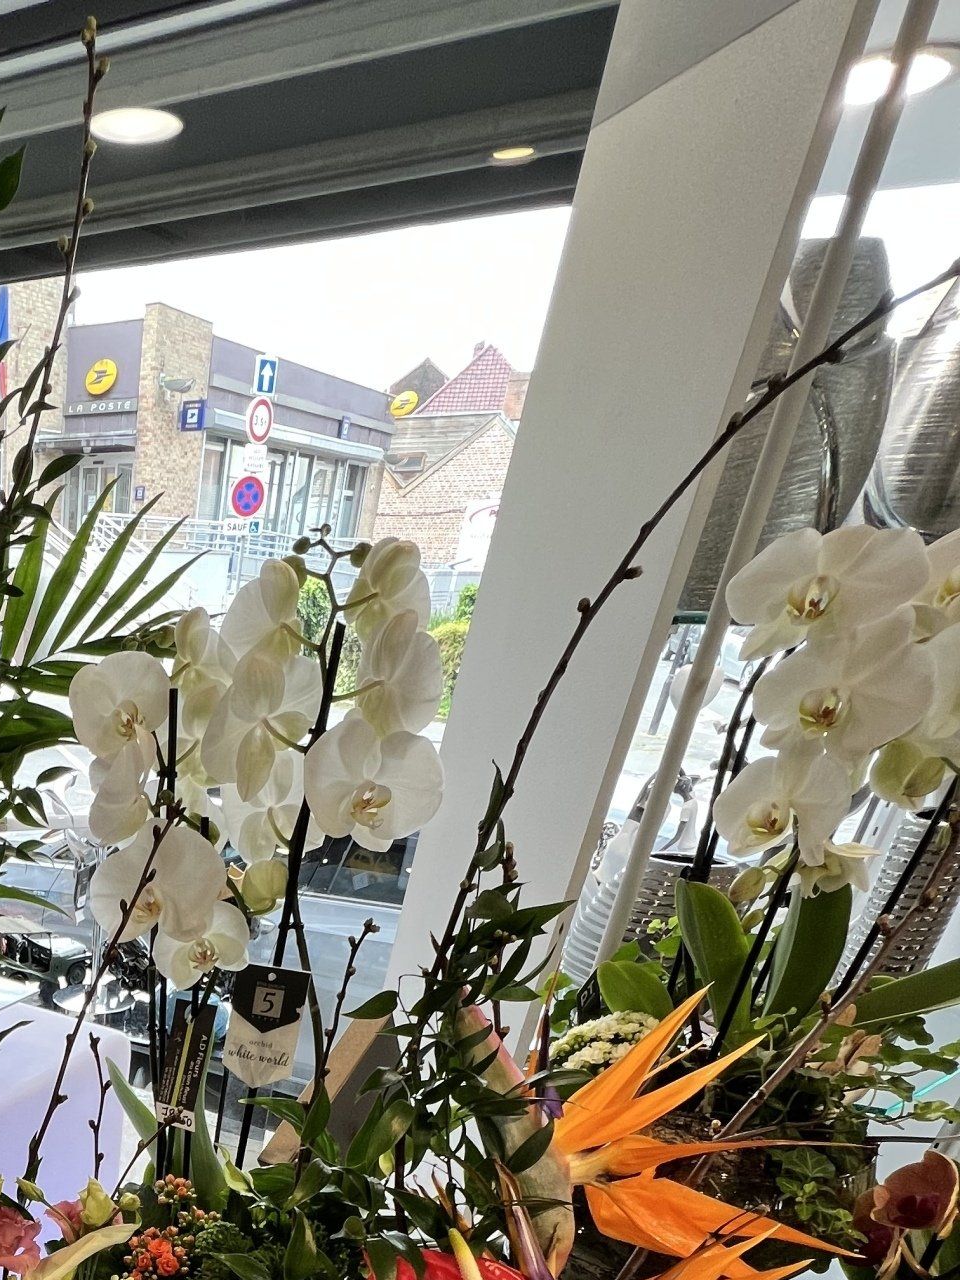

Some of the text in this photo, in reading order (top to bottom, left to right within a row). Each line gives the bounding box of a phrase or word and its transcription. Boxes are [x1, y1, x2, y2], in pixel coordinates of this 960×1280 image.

[68, 400, 131, 413] LA POSTE
[227, 522, 248, 531] SAUF
[260, 992, 277, 1013] 5
[249, 1040, 273, 1048] orchid
[228, 1043, 290, 1067] white world
[193, 1052, 204, 1078] Fleurs
